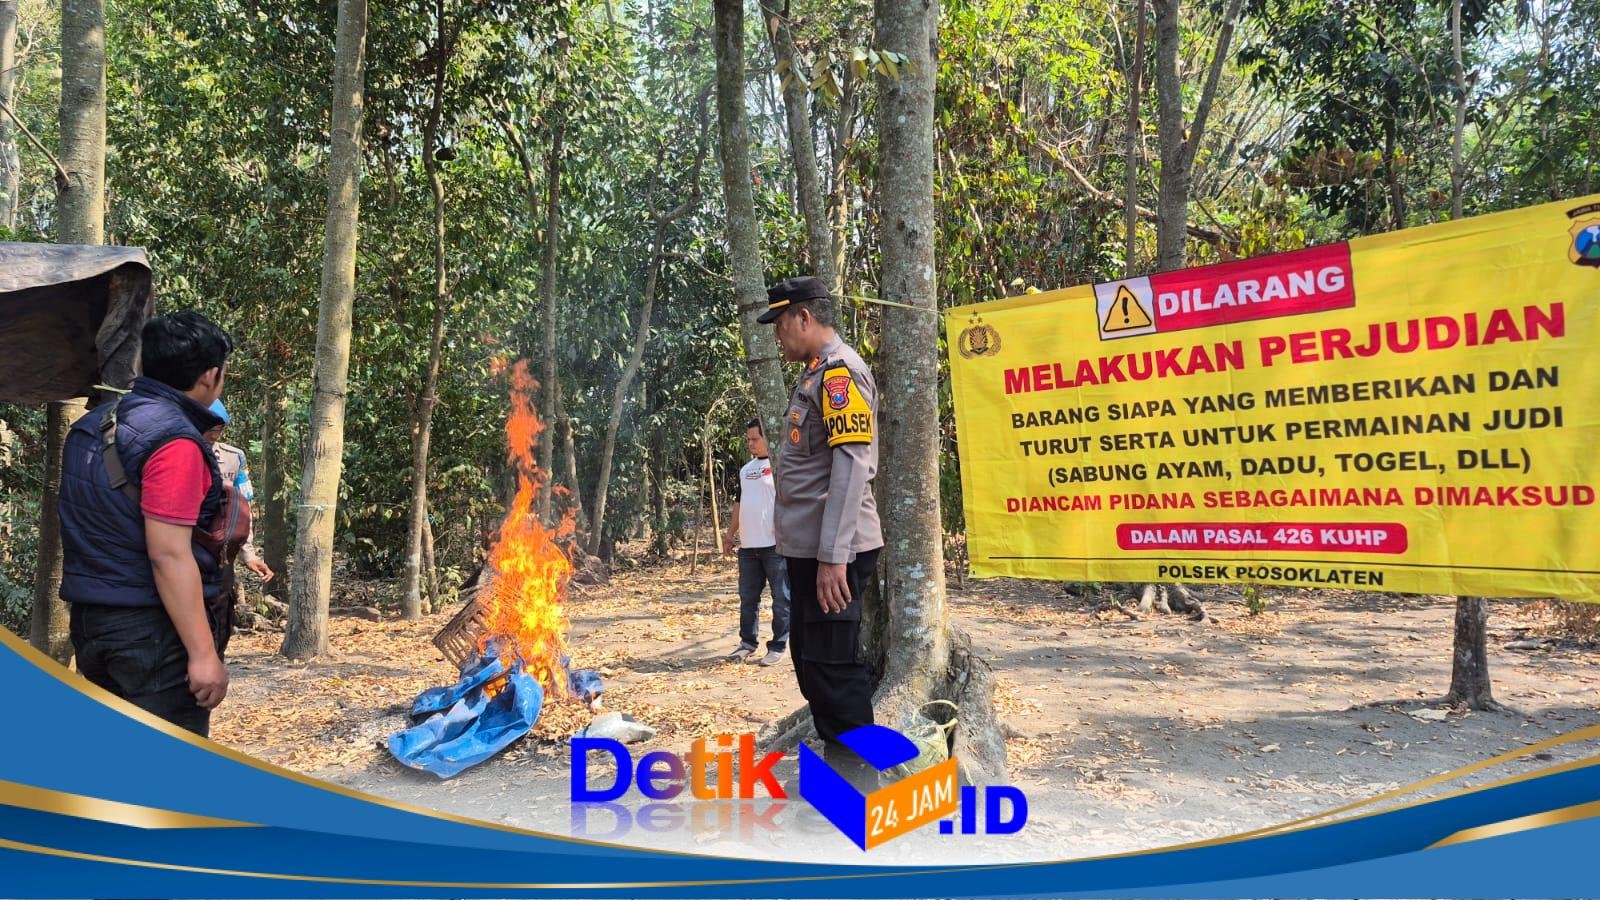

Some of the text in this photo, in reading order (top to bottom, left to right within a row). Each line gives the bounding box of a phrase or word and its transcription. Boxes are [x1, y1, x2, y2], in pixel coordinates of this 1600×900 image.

[1159, 267, 1344, 315] DILARANG
[1005, 302, 1565, 394] MELAKUKAN PERJUDIAN
[1012, 367, 1558, 428] BARANG SIAPA YANG MEMBERIKAN DAN
[1020, 407, 1562, 456] TURUT SERTA UNTUK PERMAINAN JUDI
[1049, 448, 1532, 487] (SABUNG AYAM, DADU, TOGEL, DLL)
[1007, 486, 1594, 512] DIANCAM PIDANA SEBAGAIMANA DIMAKSUD
[1131, 528, 1388, 546] DALAM PASAL 426 KUHP
[1159, 566, 1385, 586] POLSEK PLOSOKLATEN
